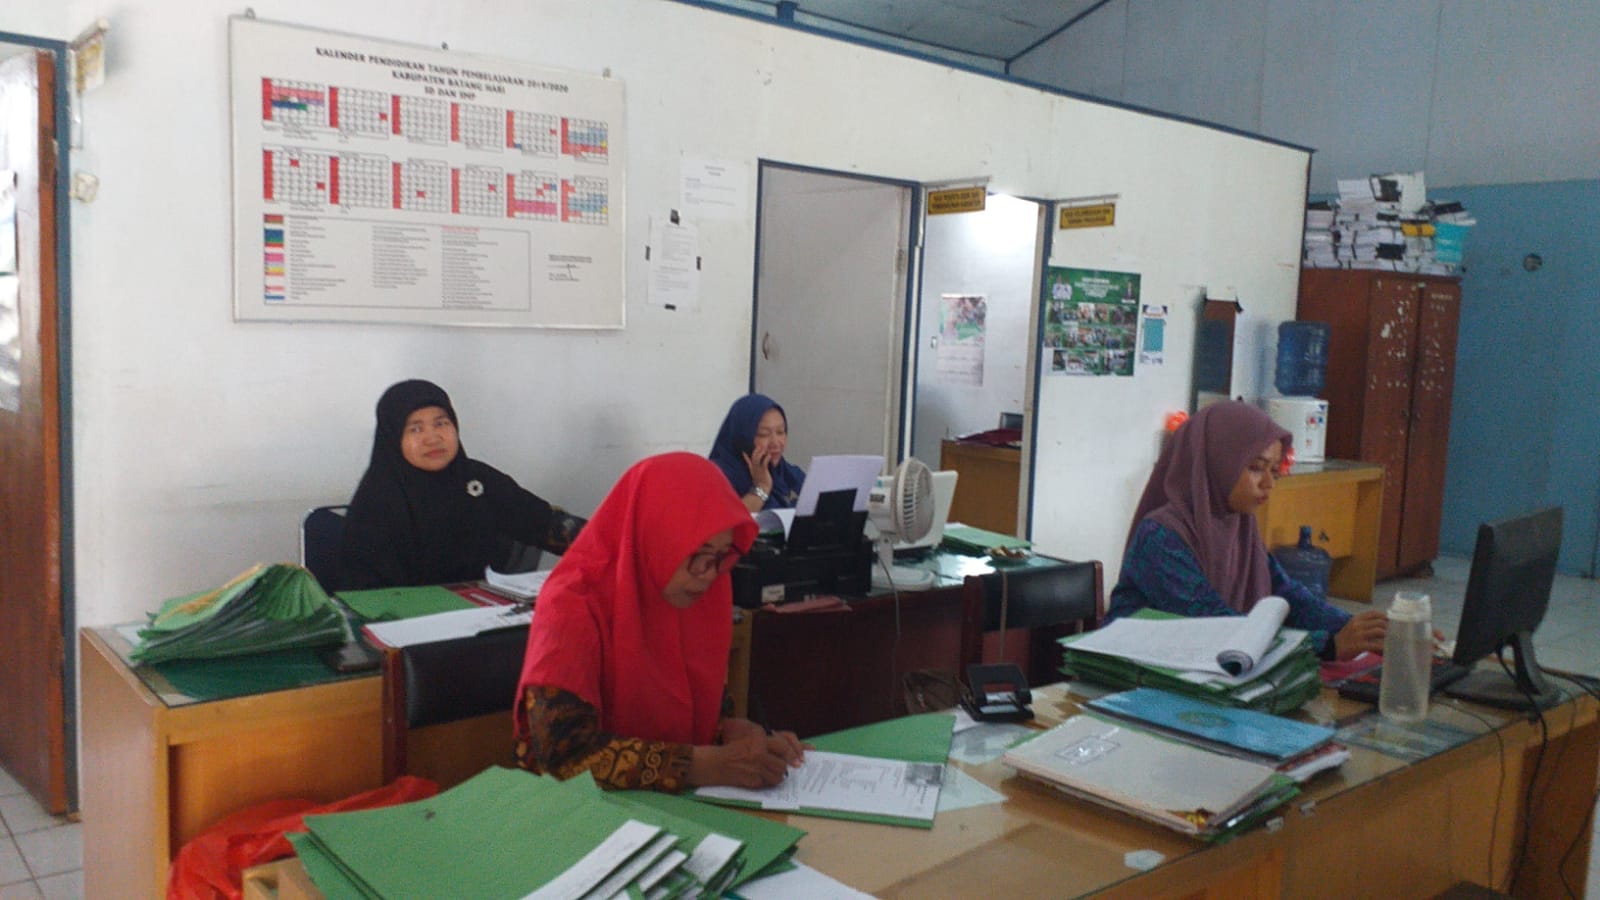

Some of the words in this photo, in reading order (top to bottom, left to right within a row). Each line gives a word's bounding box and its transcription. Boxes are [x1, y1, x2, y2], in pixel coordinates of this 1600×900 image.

[316, 46, 365, 62] KALENDER
[369, 55, 425, 70] PENDIDIKAN
[428, 63, 459, 76] TAHUN
[461, 69, 524, 86] PEMBELAJARAN
[392, 70, 445, 85] KABUPATEN
[448, 77, 482, 91] BATANG
[485, 84, 505, 94] HARI
[437, 87, 457, 97] DAN
